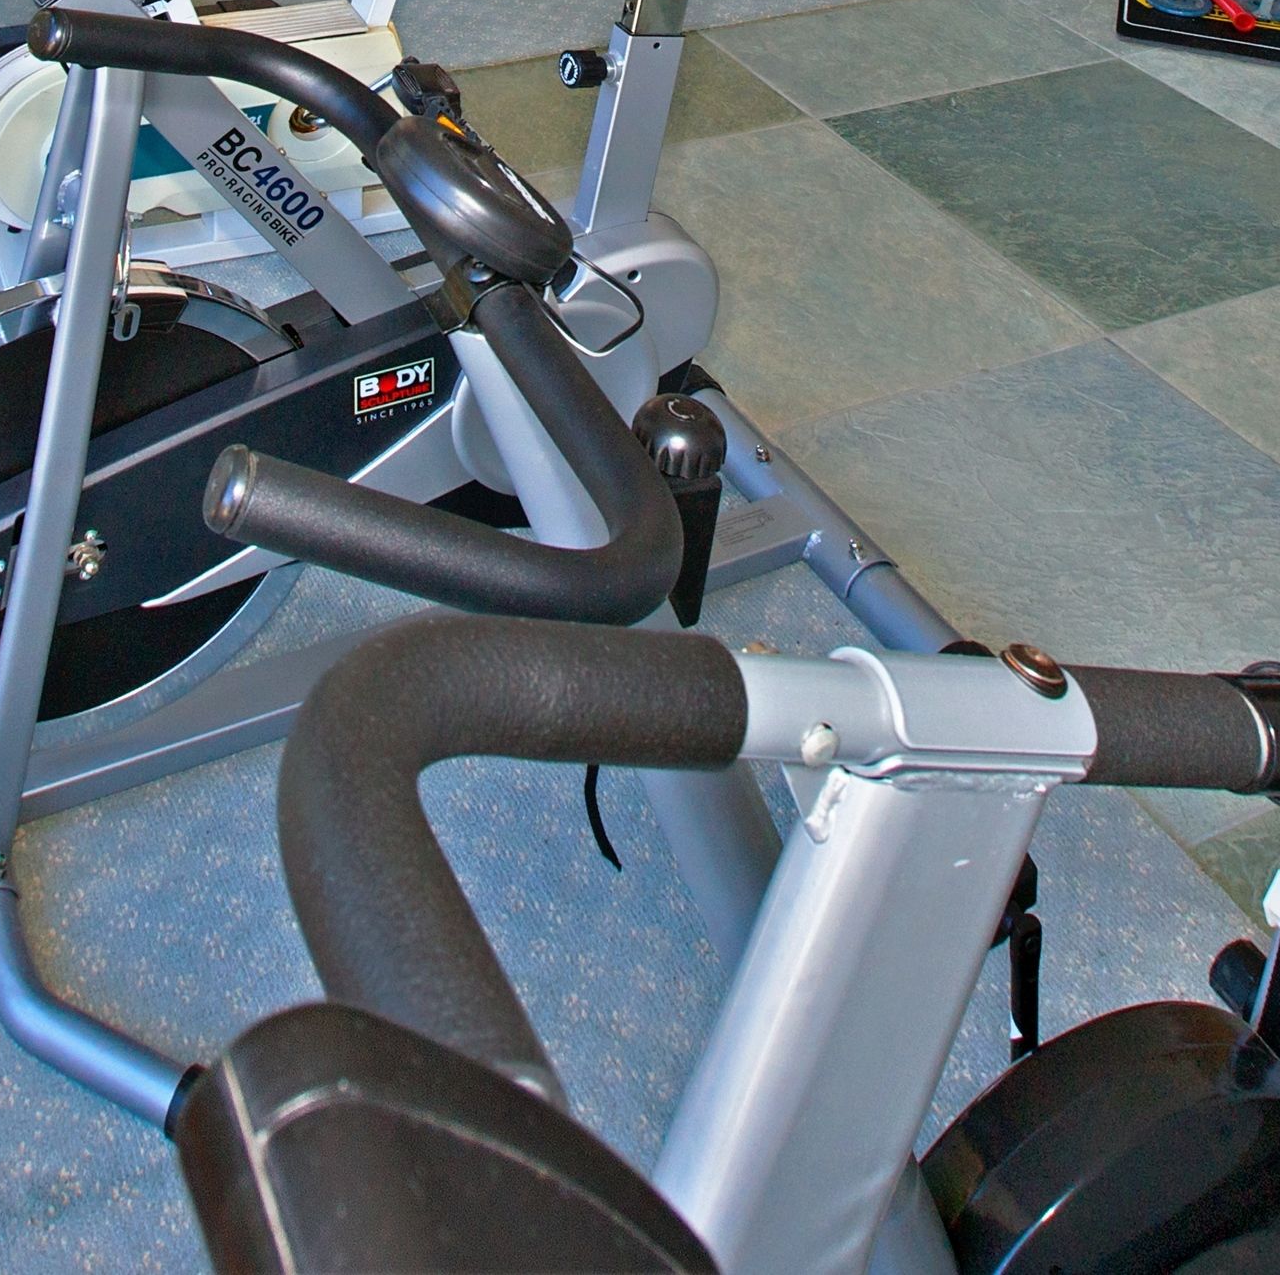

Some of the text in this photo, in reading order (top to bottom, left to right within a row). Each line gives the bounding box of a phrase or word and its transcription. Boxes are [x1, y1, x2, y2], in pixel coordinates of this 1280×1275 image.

[212, 127, 324, 230] BC4600
[360, 362, 430, 398] BODY
[360, 382, 430, 409] SCULPTURE
[356, 398, 433, 425] SINCE 1965
